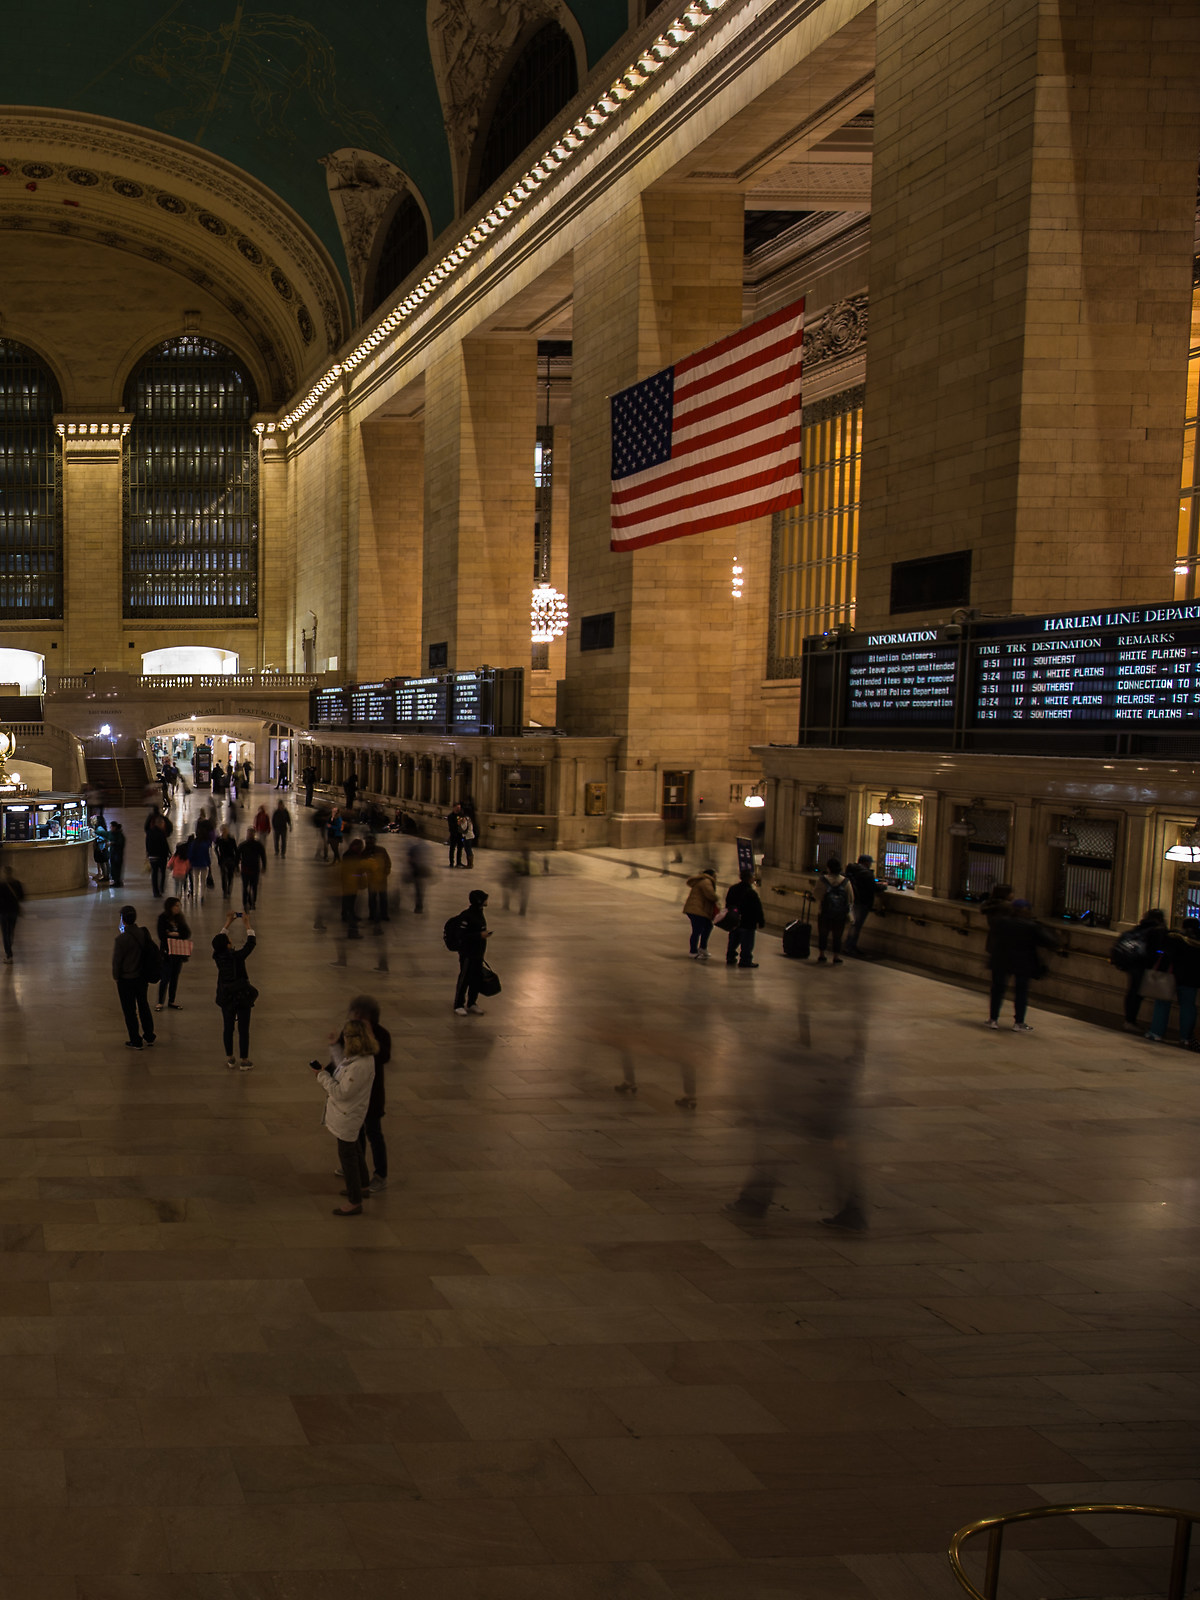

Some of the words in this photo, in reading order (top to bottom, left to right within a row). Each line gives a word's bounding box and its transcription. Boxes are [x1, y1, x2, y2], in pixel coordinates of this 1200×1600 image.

[1044, 614, 1102, 631] HARLEM
[1106, 612, 1140, 626] LINE
[1144, 606, 1200, 622] DEPART
[868, 630, 938, 646] INFORMATION
[978, 646, 1000, 654] TIME
[1006, 644, 1026, 653] TRK
[1032, 638, 1102, 652] DESTINATION
[1118, 633, 1175, 646] REMARKS
[868, 654, 899, 662] Attention
[1033, 654, 1076, 666] SOUTHEAST
[1120, 650, 1146, 660] WHITE
[1152, 648, 1186, 659] PLAINS
[917, 662, 955, 671] unattended
[1046, 669, 1070, 678] WHITE
[1073, 667, 1104, 677] PLAINS
[1118, 664, 1157, 675] MELROSE
[850, 678, 881, 686] Unattended
[916, 676, 925, 684] be
[927, 674, 954, 683] removed
[1032, 682, 1074, 692] SOUTHEAST
[1118, 679, 1173, 690] CONNECTION
[1178, 678, 1190, 688] TO
[889, 688, 910, 696] Police
[913, 687, 949, 696] Department
[912, 699, 953, 708] cooperation
[1044, 696, 1069, 705] WHITE
[1072, 696, 1103, 705] PLAINS
[1117, 694, 1155, 704] MELROSE
[1030, 710, 1073, 719] SOUTHEAST
[1116, 709, 1142, 719] WHITE
[1148, 709, 1182, 718] PLAINS
